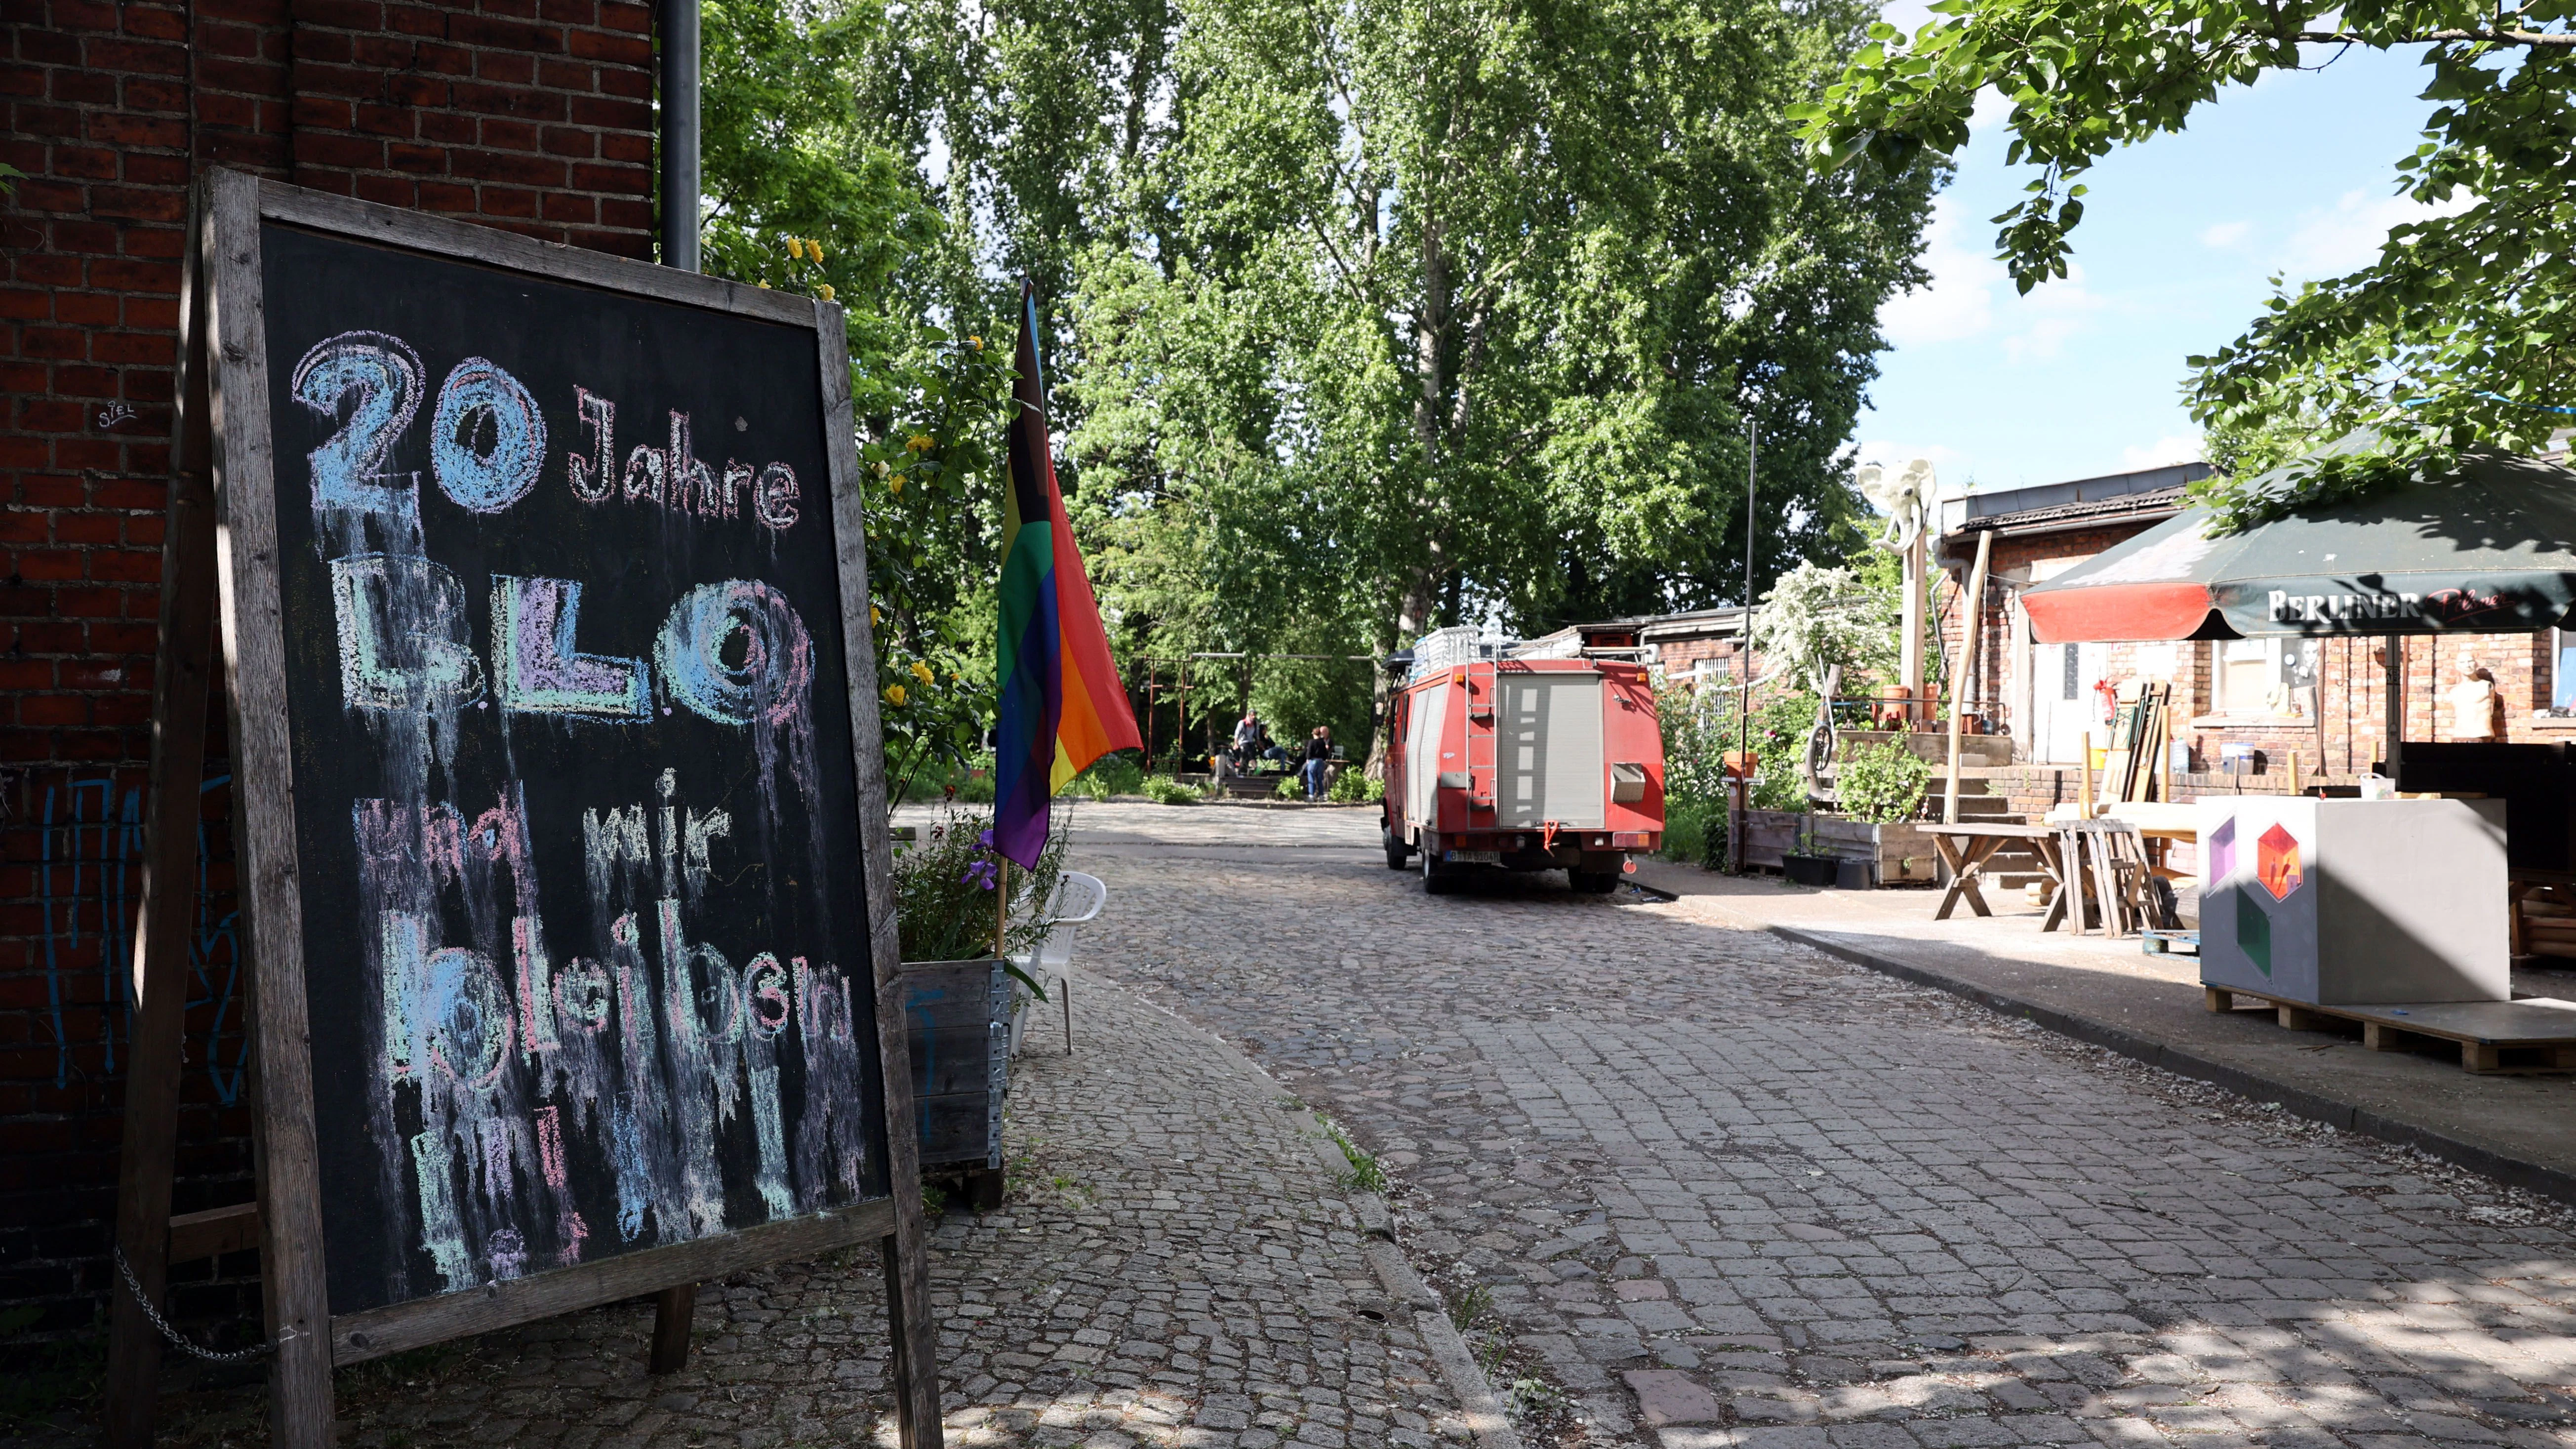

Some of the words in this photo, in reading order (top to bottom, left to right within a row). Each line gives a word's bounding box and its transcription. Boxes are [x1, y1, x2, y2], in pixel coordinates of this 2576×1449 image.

[292, 330, 547, 514] 20
[568, 384, 802, 529] Jahre
[2269, 590, 2420, 623] BERLINER
[2425, 588, 2515, 620] Pilsner
